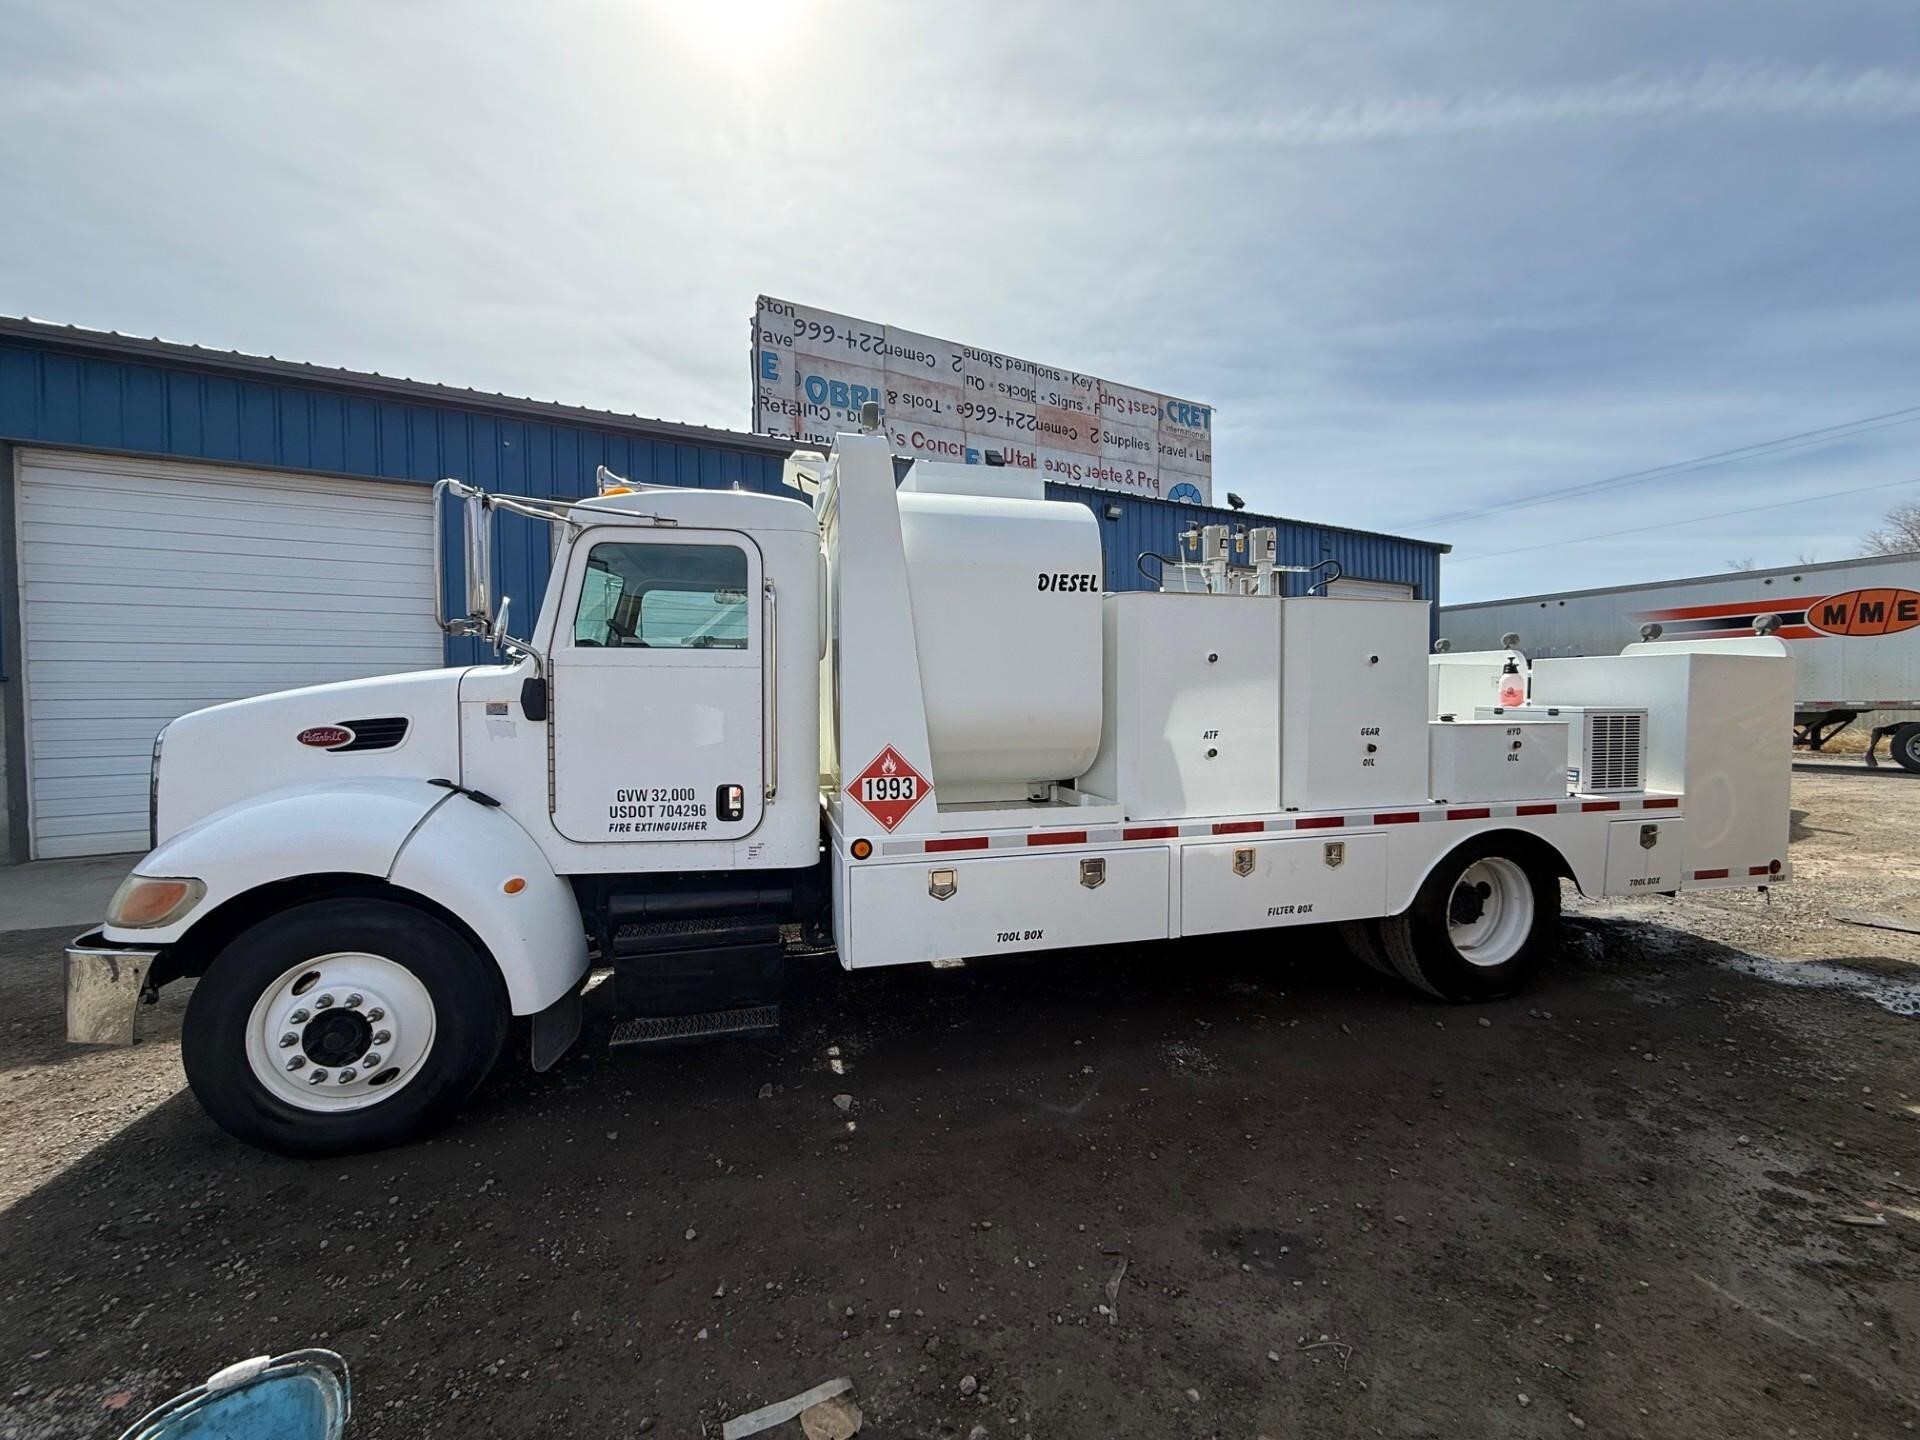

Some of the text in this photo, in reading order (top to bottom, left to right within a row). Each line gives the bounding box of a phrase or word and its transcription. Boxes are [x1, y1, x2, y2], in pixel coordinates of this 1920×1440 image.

[963, 348, 1002, 369] Stone
[1071, 373, 1093, 392] Key
[998, 381, 1036, 403] Blocks
[902, 393, 942, 414] Tools
[1048, 392, 1084, 412] Signs
[1128, 400, 1158, 418] cast
[1102, 431, 1151, 452] Supplies
[1044, 458, 1081, 481] Store
[1125, 469, 1137, 485] &
[1137, 471, 1160, 490] Pre
[1037, 573, 1098, 592] DIESEL
[1203, 730, 1219, 740] ATF
[1360, 727, 1380, 737] GEAR
[1506, 727, 1521, 736] HYD
[1362, 758, 1375, 767] OIL
[1507, 753, 1519, 762] OIL
[617, 788, 695, 803] GVW 32,000
[865, 777, 913, 801] 1993
[609, 804, 707, 819] USDOT 704296
[608, 821, 708, 833] FIRE EXTINGUISHER
[886, 816, 893, 825] 3
[1629, 876, 1661, 887] TOOL BOX
[1267, 903, 1314, 917] FILTER BOX
[996, 929, 1044, 943] TOOL BOX
